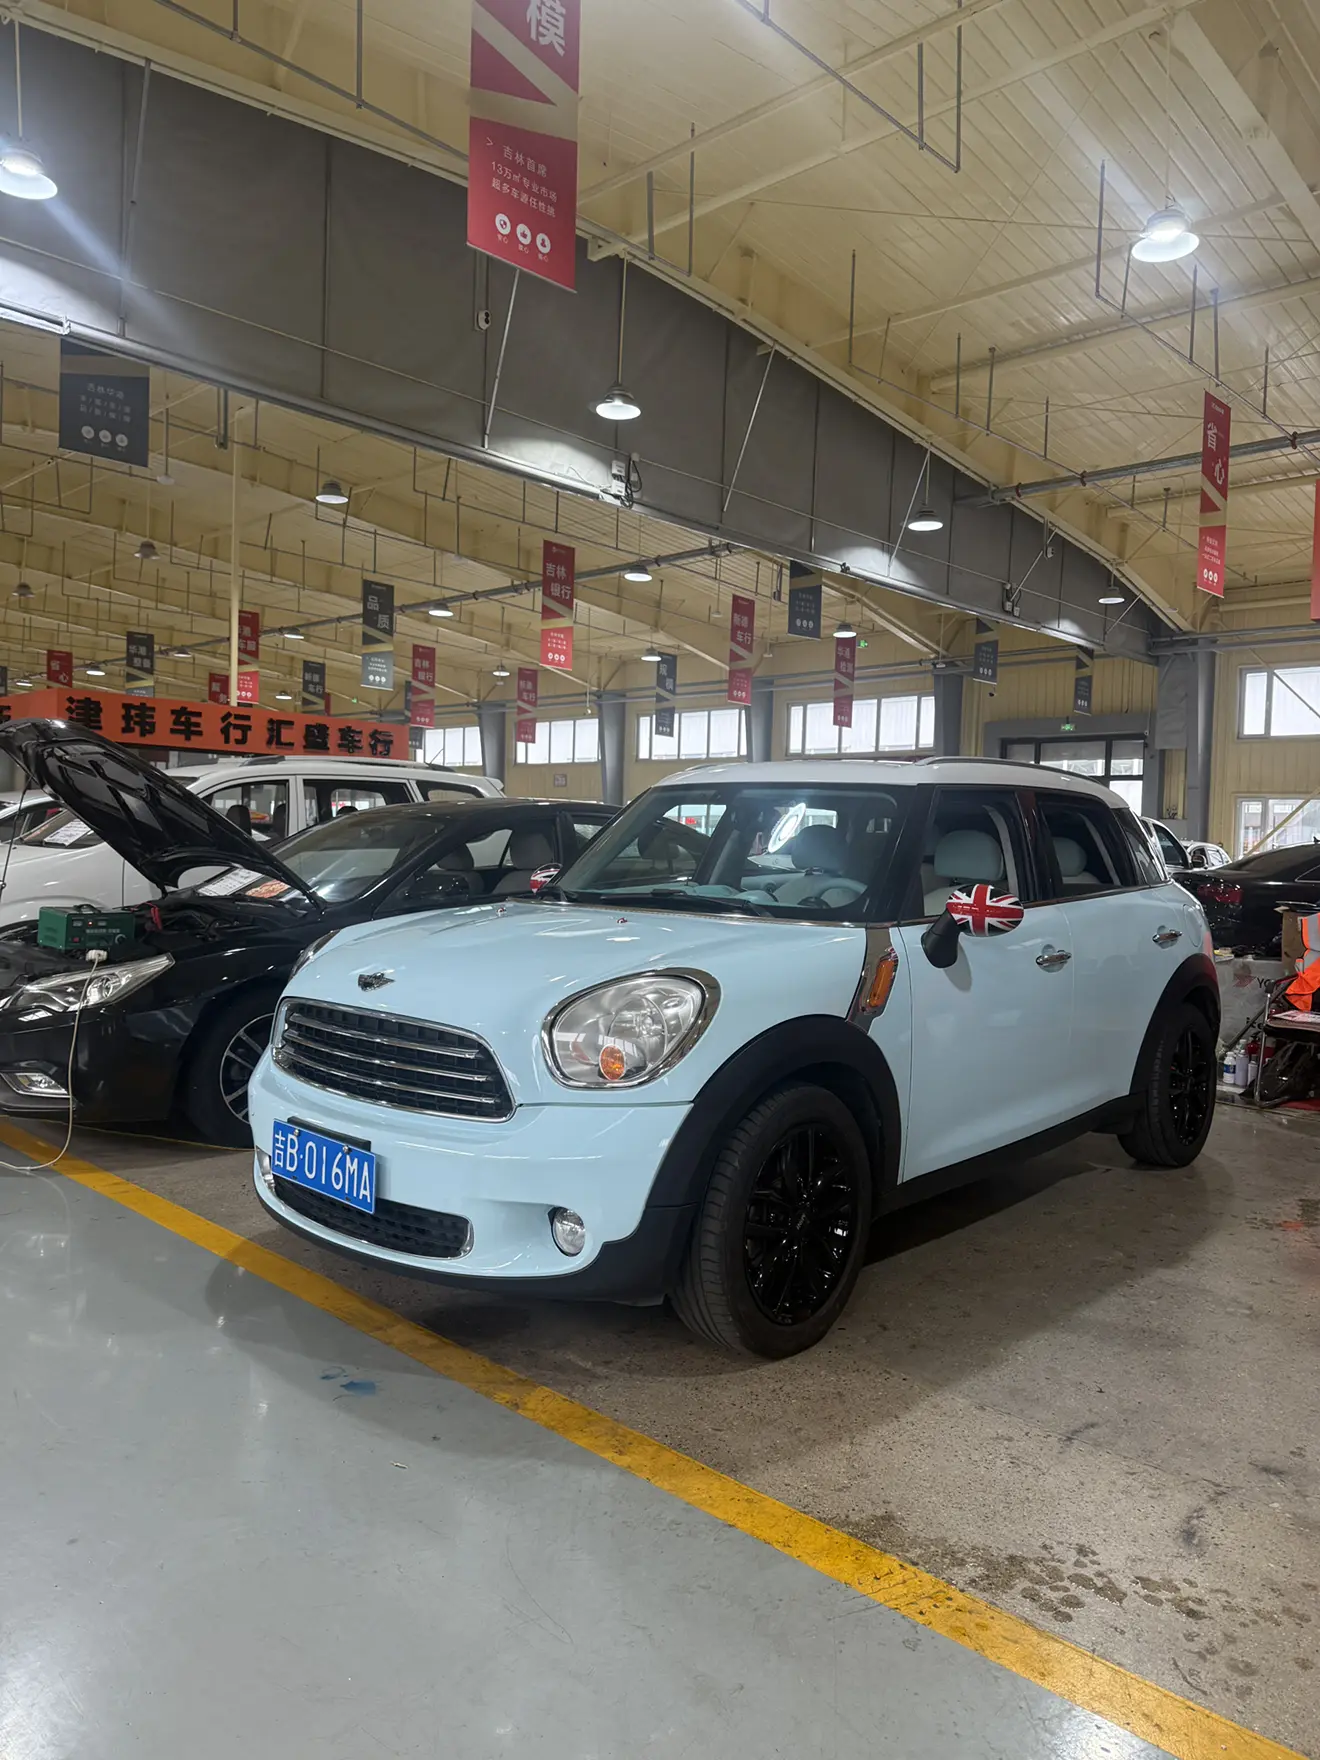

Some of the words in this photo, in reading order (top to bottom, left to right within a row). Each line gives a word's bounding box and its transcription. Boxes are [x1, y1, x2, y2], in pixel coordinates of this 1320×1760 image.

[526, 0, 566, 57] 模
[503, 145, 547, 178] 吉林首席
[545, 562, 567, 580] 吉林
[550, 582, 572, 600] 银行
